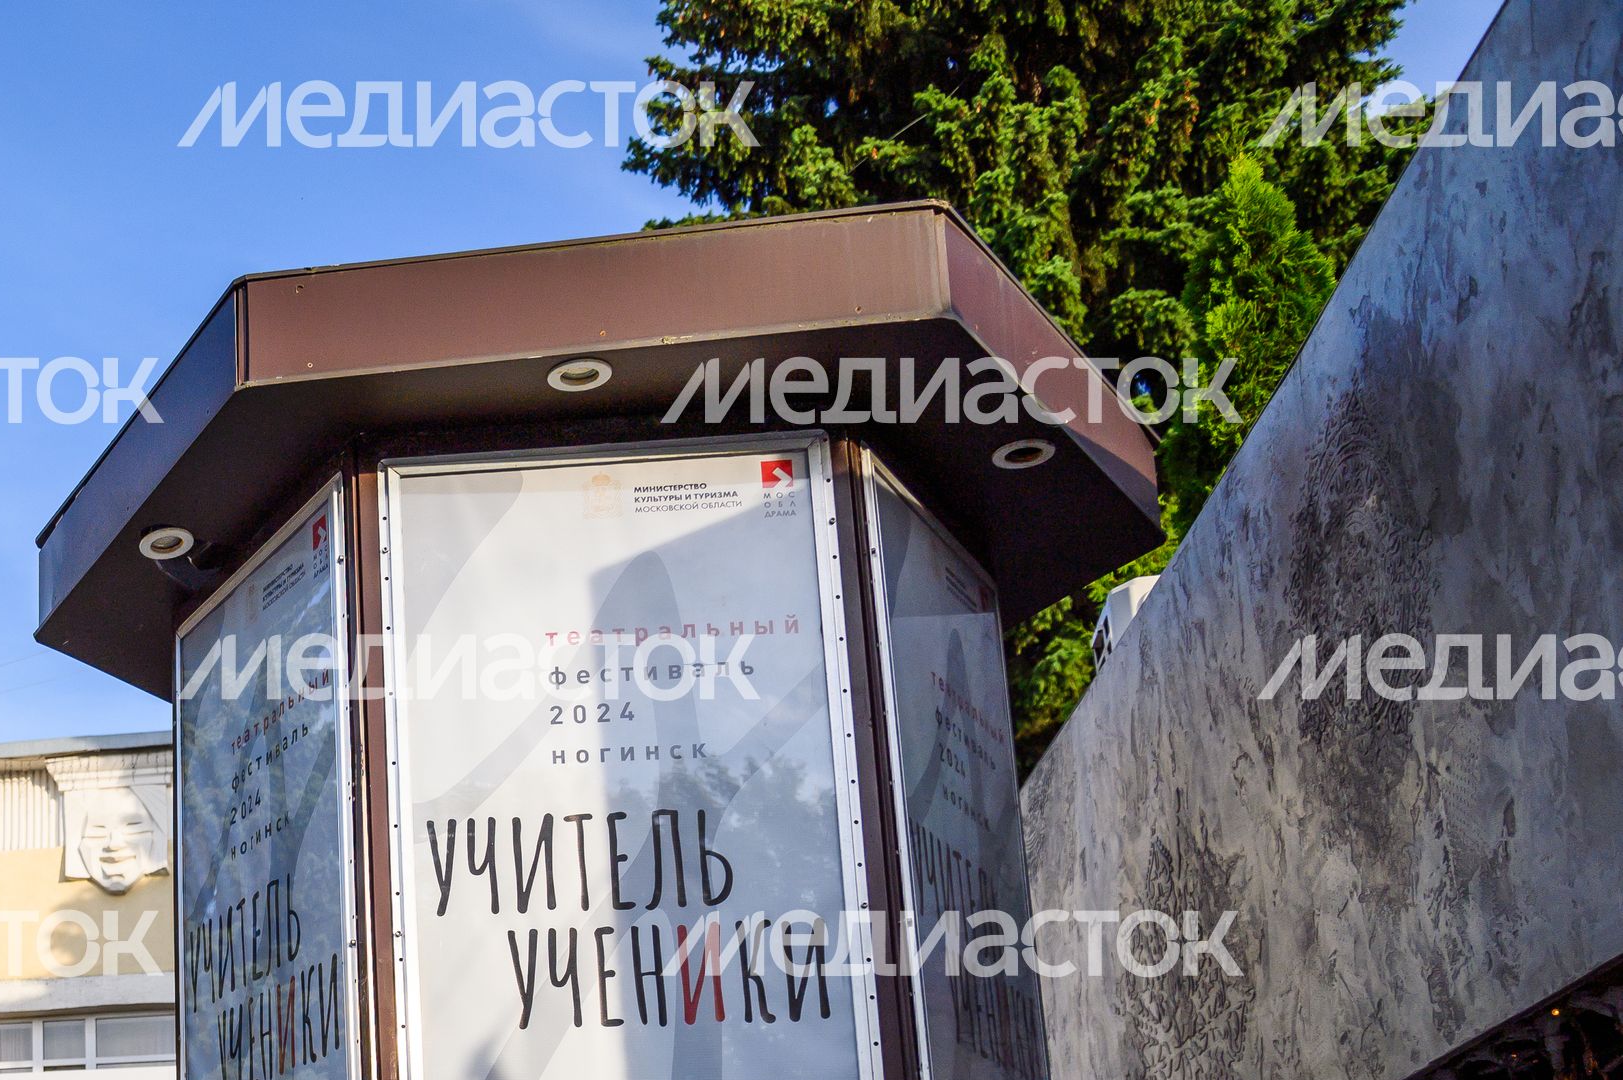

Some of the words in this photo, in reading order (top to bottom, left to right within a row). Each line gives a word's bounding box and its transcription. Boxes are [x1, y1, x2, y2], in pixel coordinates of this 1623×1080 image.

[633, 482, 708, 494] МИНИСТЕРСТВО
[634, 493, 683, 504] КУЛЬТУРЫ
[694, 490, 739, 500] ТУРИЗМА
[634, 501, 699, 513] МОСКОВСКОЙ
[701, 500, 743, 510] ОБЛАСТИ
[764, 509, 797, 519] ДРАМА
[544, 613, 800, 648] театральный
[547, 660, 755, 690] фестиваль
[231, 669, 331, 756] театральный
[549, 701, 635, 725] 2024
[230, 722, 310, 794] фестиваль
[551, 742, 708, 765] ногинск
[938, 742, 966, 780] 2024
[229, 795, 262, 827] 2024
[229, 811, 291, 861] ногинск
[426, 808, 734, 918] УЧИТЕЛЬ
[190, 873, 302, 1013] УЧИТЕЛЬ
[507, 917, 832, 1030] УЧЕНИКИ
